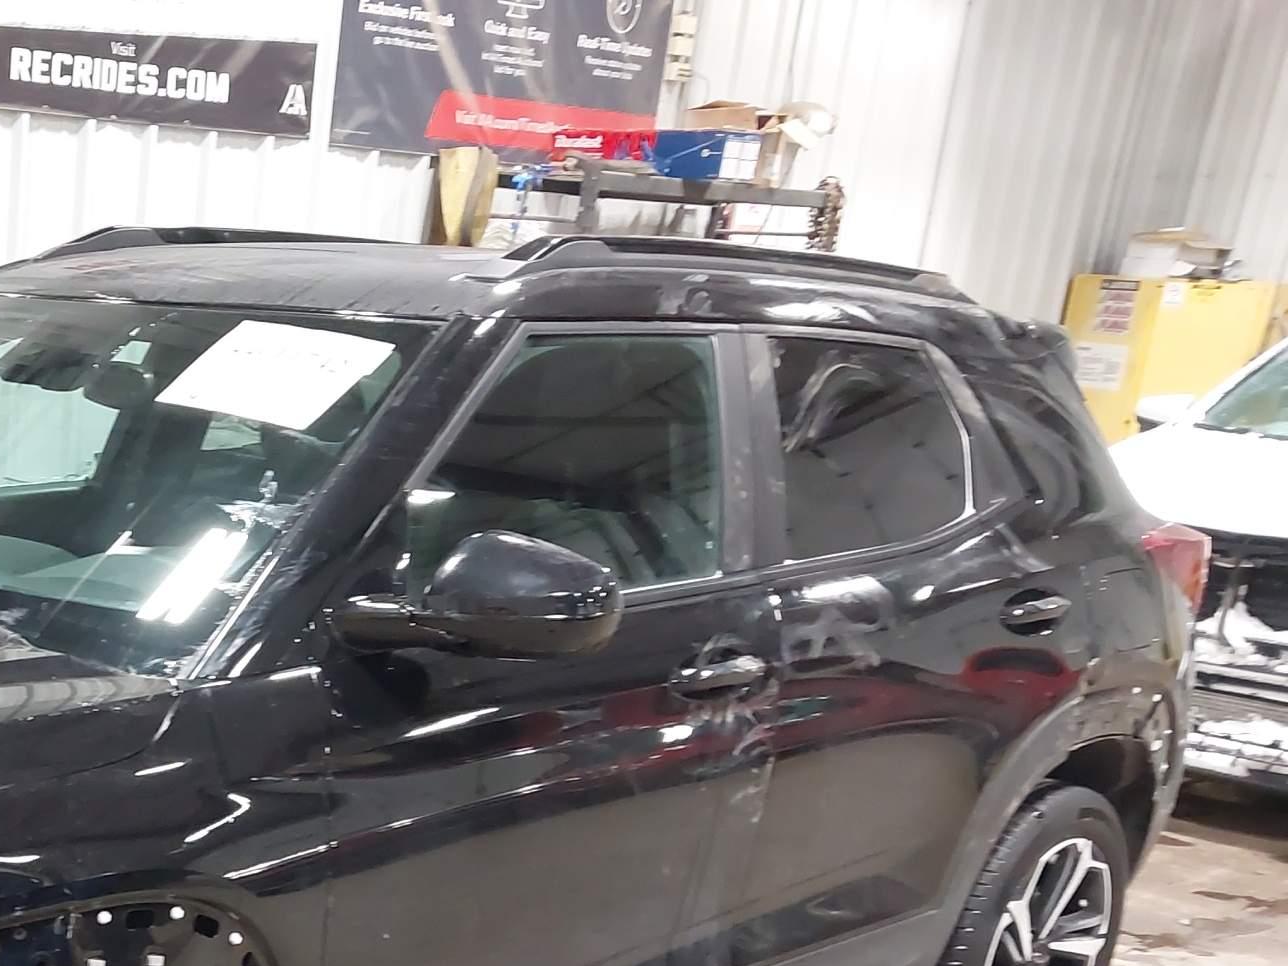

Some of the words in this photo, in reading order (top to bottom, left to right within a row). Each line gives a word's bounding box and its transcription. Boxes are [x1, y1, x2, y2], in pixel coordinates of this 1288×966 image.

[484, 20, 508, 36] Quick
[507, 26, 527, 38] and
[527, 27, 551, 45] Easy
[110, 41, 137, 57] Visit
[9, 47, 230, 104] RECRIDES.COM
